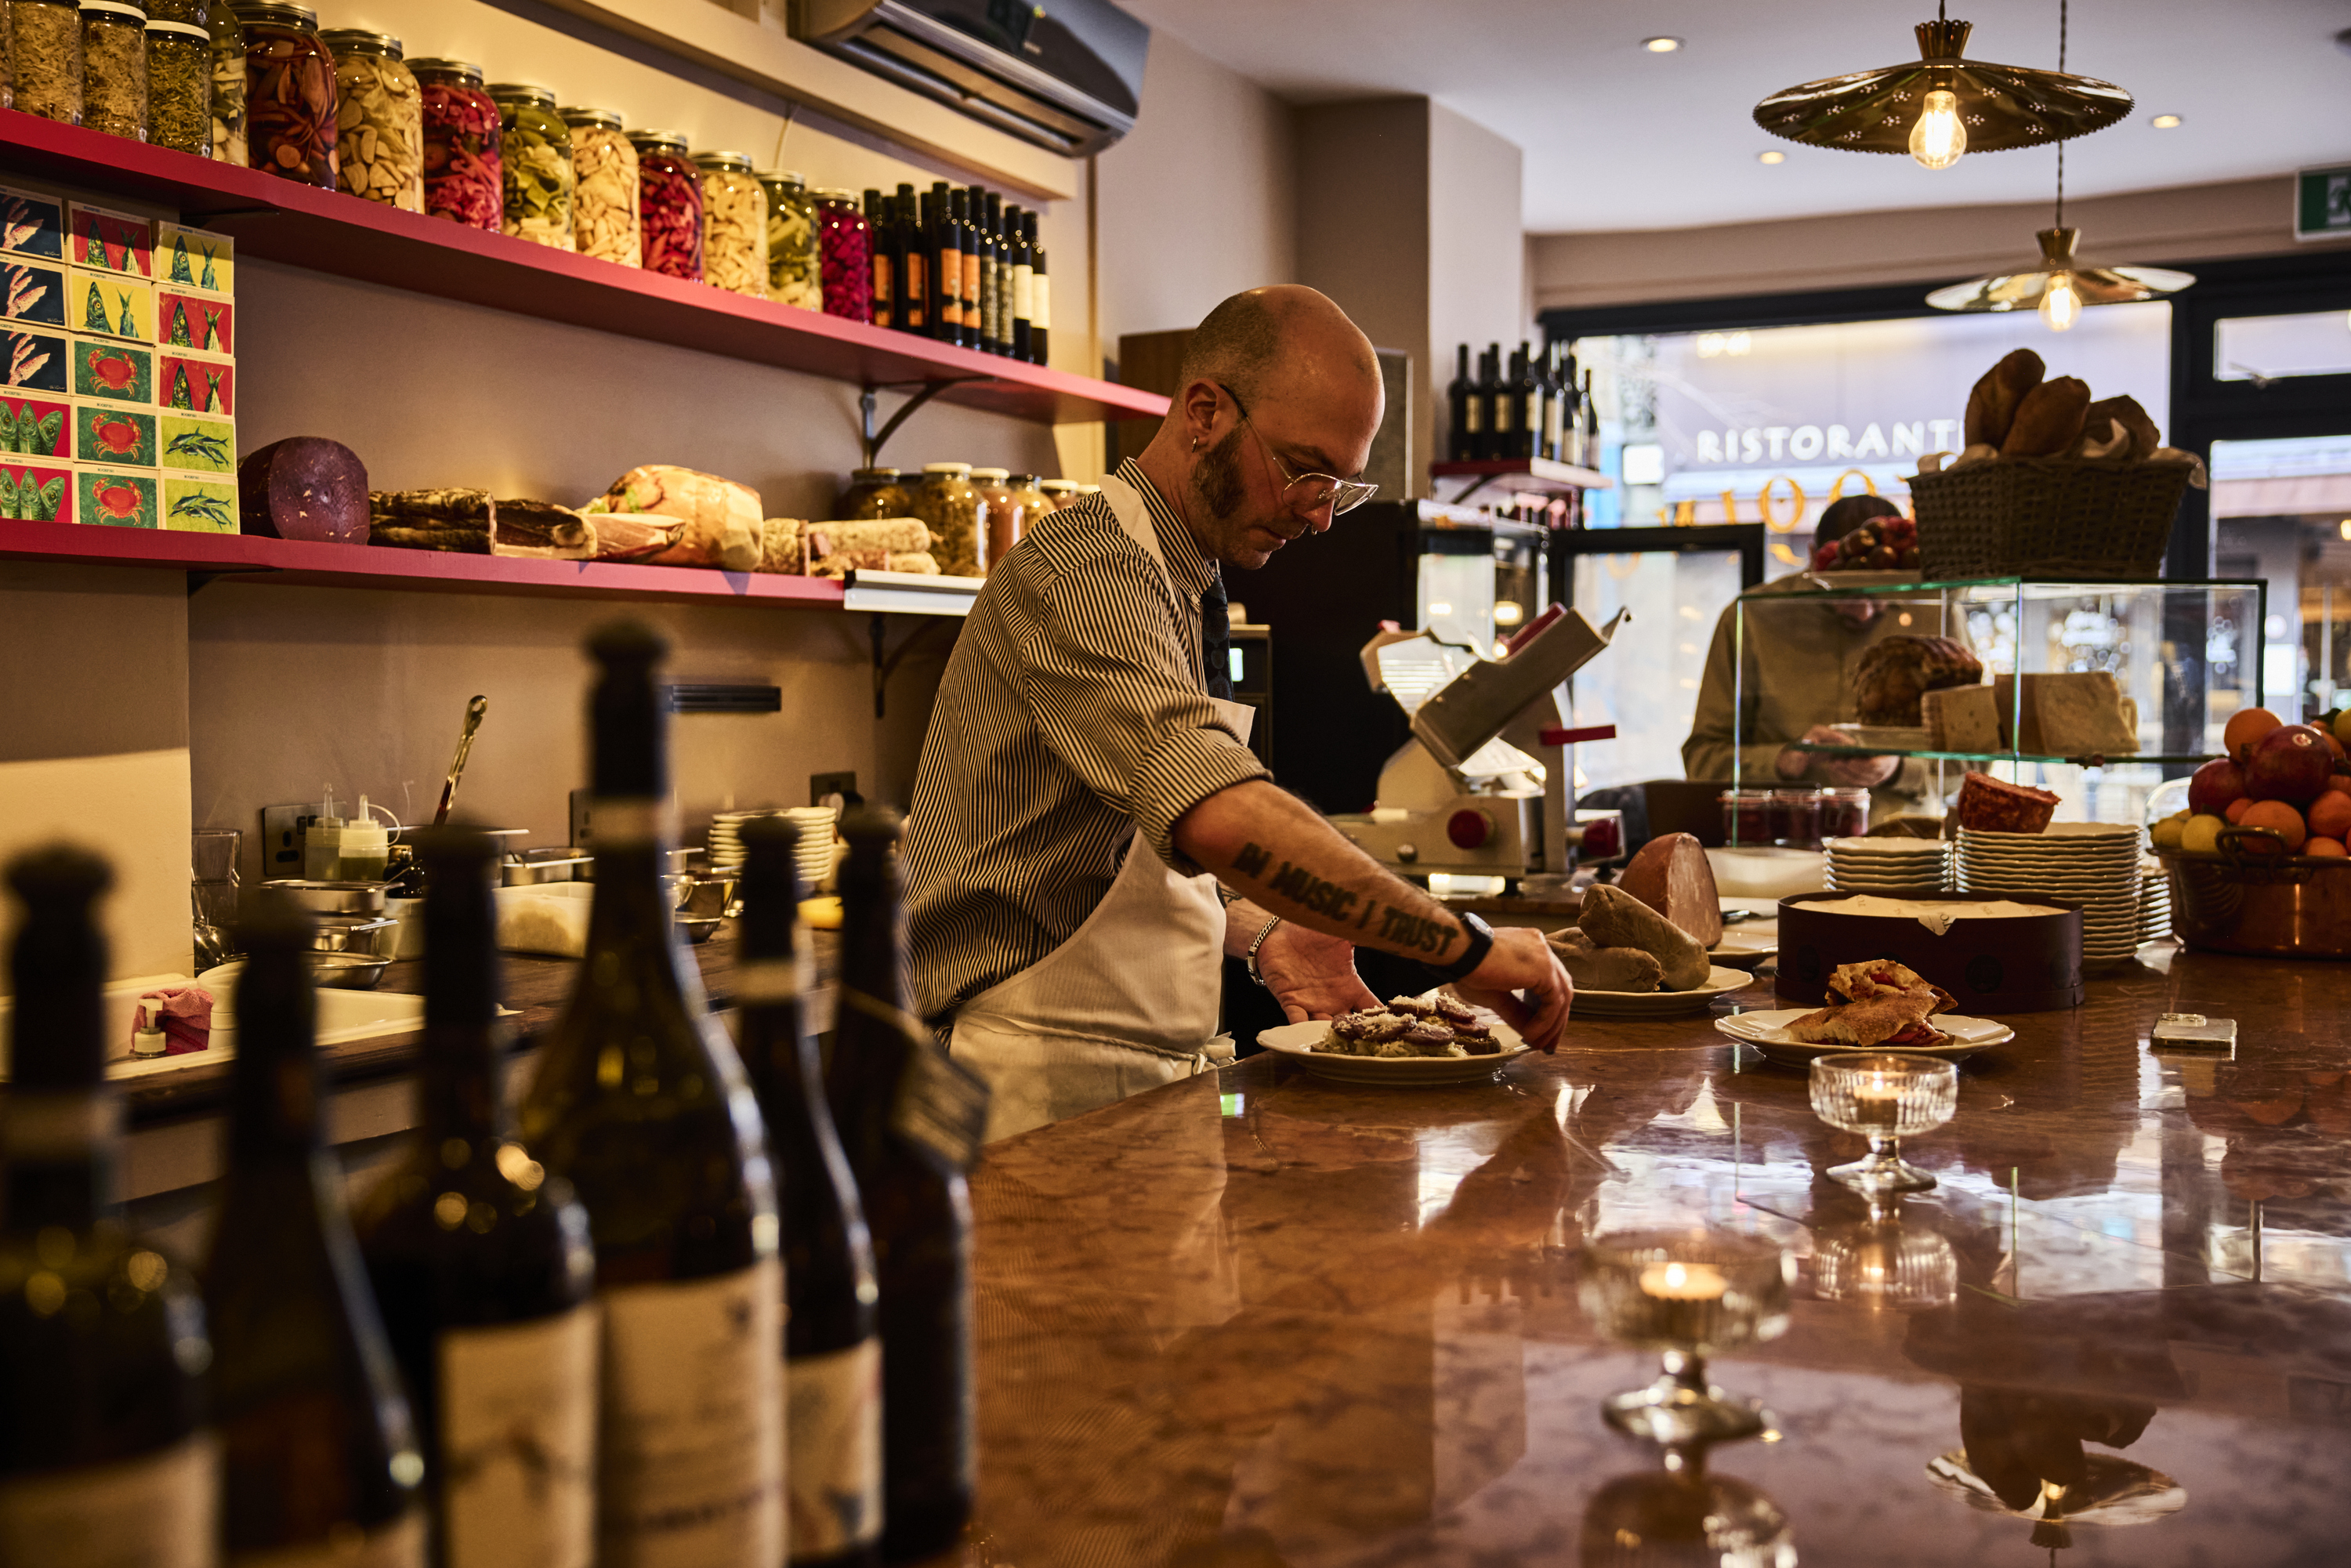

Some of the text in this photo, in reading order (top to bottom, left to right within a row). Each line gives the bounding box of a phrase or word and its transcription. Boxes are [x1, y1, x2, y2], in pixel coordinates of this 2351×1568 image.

[1268, 861, 1358, 922] MUSIC
[1357, 899, 1377, 929] I
[1378, 905, 1459, 957] TRUST
